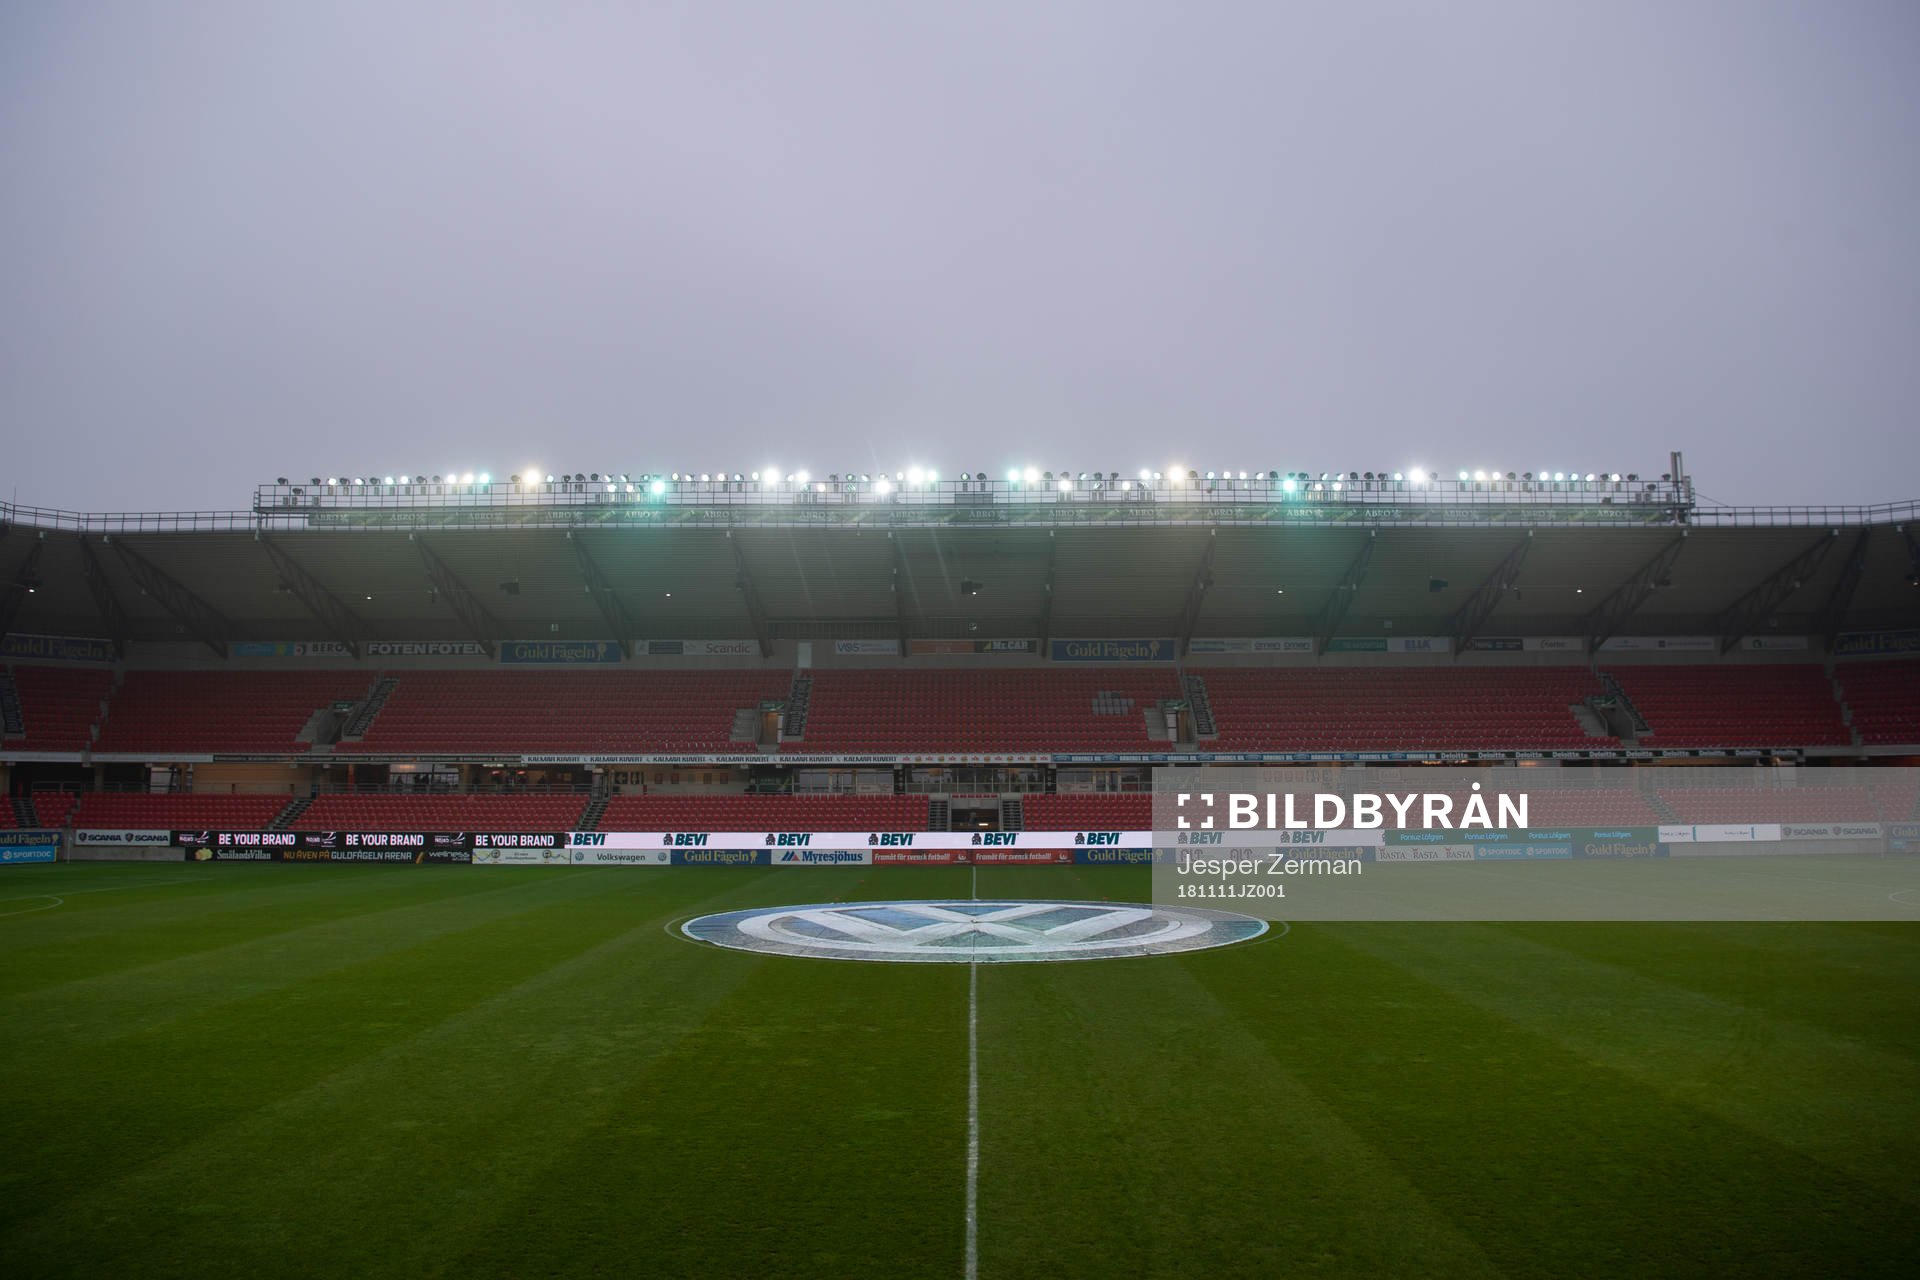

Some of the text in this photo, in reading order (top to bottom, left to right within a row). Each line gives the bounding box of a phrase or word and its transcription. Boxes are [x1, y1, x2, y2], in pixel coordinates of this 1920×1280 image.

[515, 643, 548, 659] Guld
[705, 643, 750, 654] Scandic
[1066, 642, 1100, 657] Guld
[1842, 827, 1878, 835] SCANIA
[88, 834, 122, 842] SCANIA
[218, 834, 231, 845] BE
[233, 834, 261, 845] YOUR
[262, 834, 296, 845] BRAND
[346, 834, 359, 845] BE
[361, 834, 388, 845] YOUR
[389, 834, 424, 845] BRAND
[475, 835, 554, 846] BE YOUR BRAND
[573, 834, 605, 845] BEVI
[675, 834, 707, 845] BEVI
[777, 834, 810, 846] BEVI
[880, 833, 913, 845] BEVI
[983, 833, 1016, 845] BEVI
[1086, 833, 1119, 845] BEVI
[1189, 832, 1222, 844] BEVI
[1292, 831, 1325, 843] BEVI
[217, 849, 271, 859] SmålandsVillan
[283, 851, 296, 859] NU
[331, 849, 382, 860] GULDFÅGELN
[384, 851, 412, 860] ARENA
[428, 850, 470, 858] wellness
[1087, 849, 1152, 863] Guld Fågeln
[1289, 848, 1314, 859] Guld
[1380, 851, 1406, 859] RASTA
[1413, 850, 1438, 859] RASTA
[1446, 850, 1471, 858] RASTA
[1585, 844, 1648, 857] Guld Fågeln
[597, 853, 645, 862] Volkswagen
[684, 851, 748, 864] Guld Fågeln
[802, 851, 863, 864] Myresjöhus
[874, 853, 896, 861] Framåt
[897, 853, 907, 861] för
[907, 853, 927, 861] svensk
